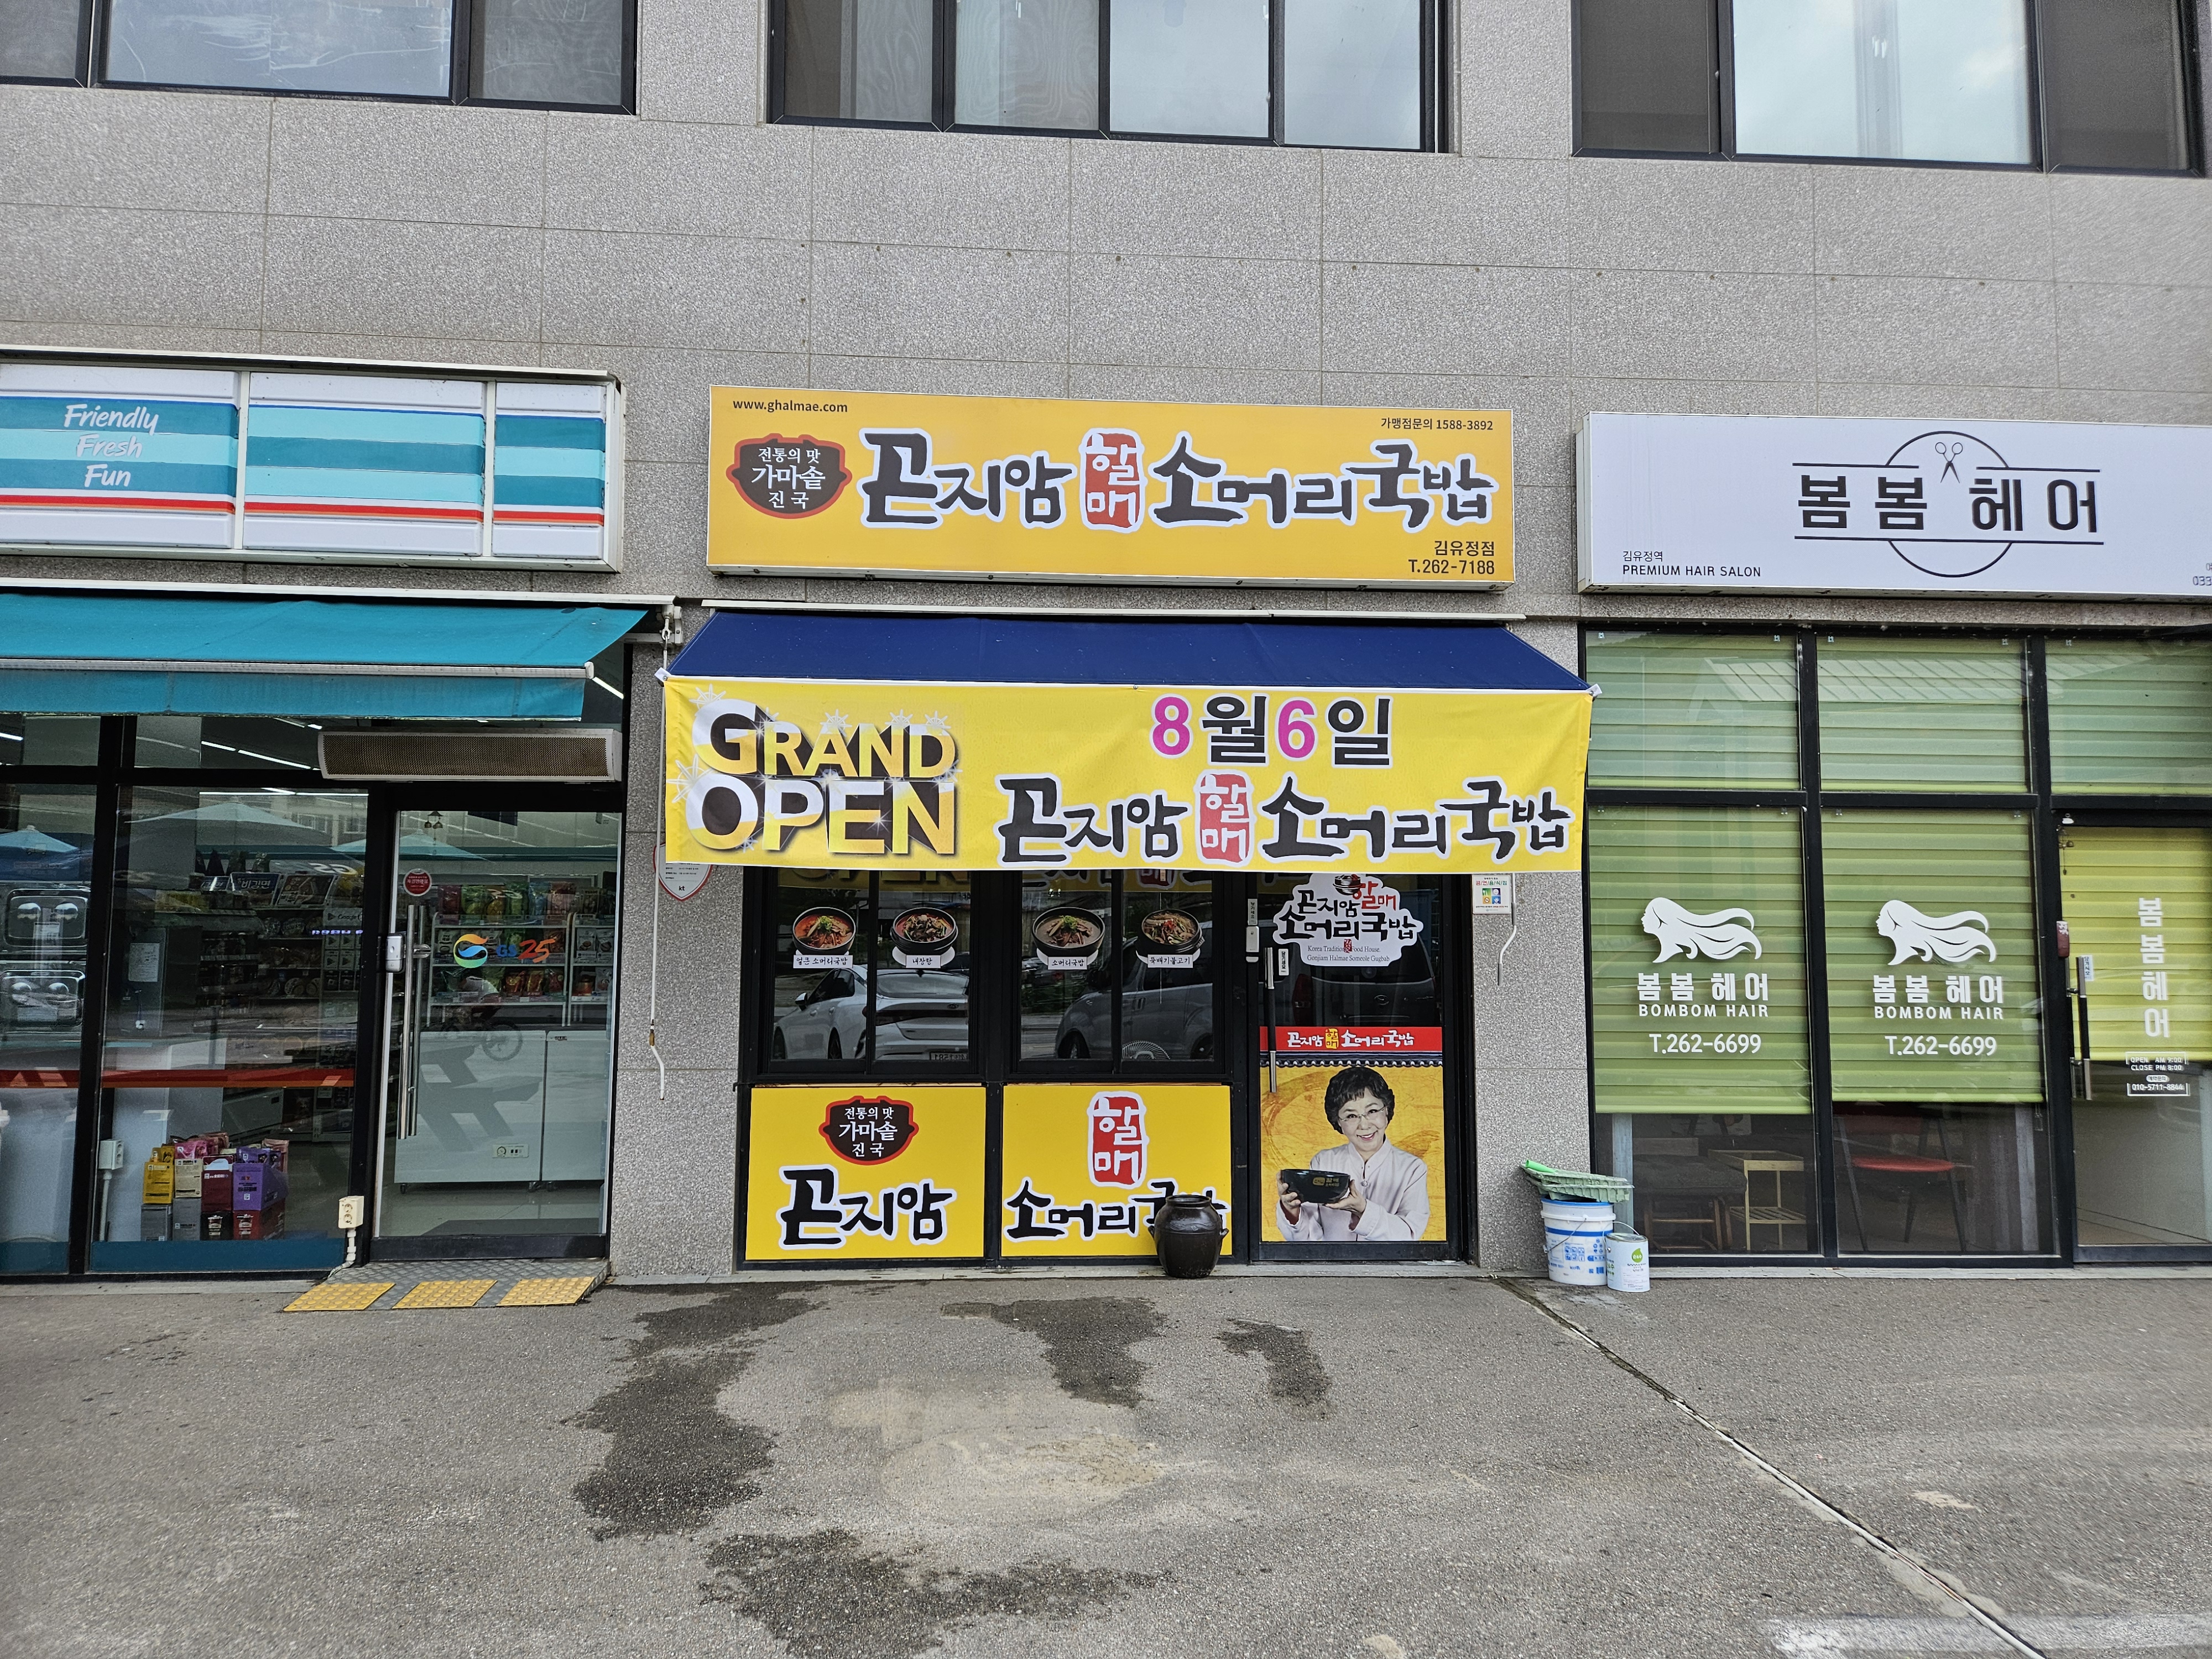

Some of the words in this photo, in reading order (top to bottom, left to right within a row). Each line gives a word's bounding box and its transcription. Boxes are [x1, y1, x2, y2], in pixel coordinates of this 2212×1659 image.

[733, 398, 848, 413] www.ghalmae.com
[65, 403, 159, 436] Friendly
[1381, 418, 1433, 430] 가맹점문의
[1436, 419, 1493, 431] 1588-3892
[76, 434, 143, 460] Fresh
[758, 447, 801, 463] 전통의
[806, 448, 821, 463] 맛
[85, 464, 131, 489] Fun
[751, 464, 826, 490] 가마솥
[862, 432, 1073, 524] 곤지암
[1152, 435, 1494, 529] 소머리국밥
[1434, 541, 1495, 557] 김유정점
[1623, 551, 1663, 562] 김유정역
[1408, 559, 1495, 575] T.262-7188
[1623, 565, 1681, 576] PREMIUM
[1686, 565, 1715, 576] HAIR
[1720, 566, 1761, 577] SALON
[691, 698, 957, 778] GRAND
[685, 774, 956, 854] OPEN
[998, 778, 1188, 863] 곤지암
[1261, 776, 1572, 860] 소머리국밥
[1297, 889, 1361, 918] 곤지암
[1279, 905, 1417, 942] 소머리국밥
[812, 957, 848, 966] 소머리국밥
[1051, 958, 1085, 967] 소머리국밥
[1149, 956, 1191, 966] 뚝배기불고기
[1307, 954, 1328, 962] Gonjiam
[1639, 1004, 1717, 1017] BOMBOM
[1726, 1004, 1768, 1017] HAIR
[1874, 1005, 1952, 1019] BOMBOM
[1961, 1006, 2004, 1020] HAIR
[1287, 1031, 1324, 1047] 곤지암
[1340, 1029, 1415, 1047] 소머리국밥
[1648, 1033, 1762, 1054] T.262-6699
[1884, 1035, 1997, 1056] T.262-6699
[844, 1107, 878, 1120] 전통의
[882, 1107, 894, 1120] 맛
[838, 1121, 898, 1142] 가마솥
[780, 1168, 953, 1245] 곤지암
